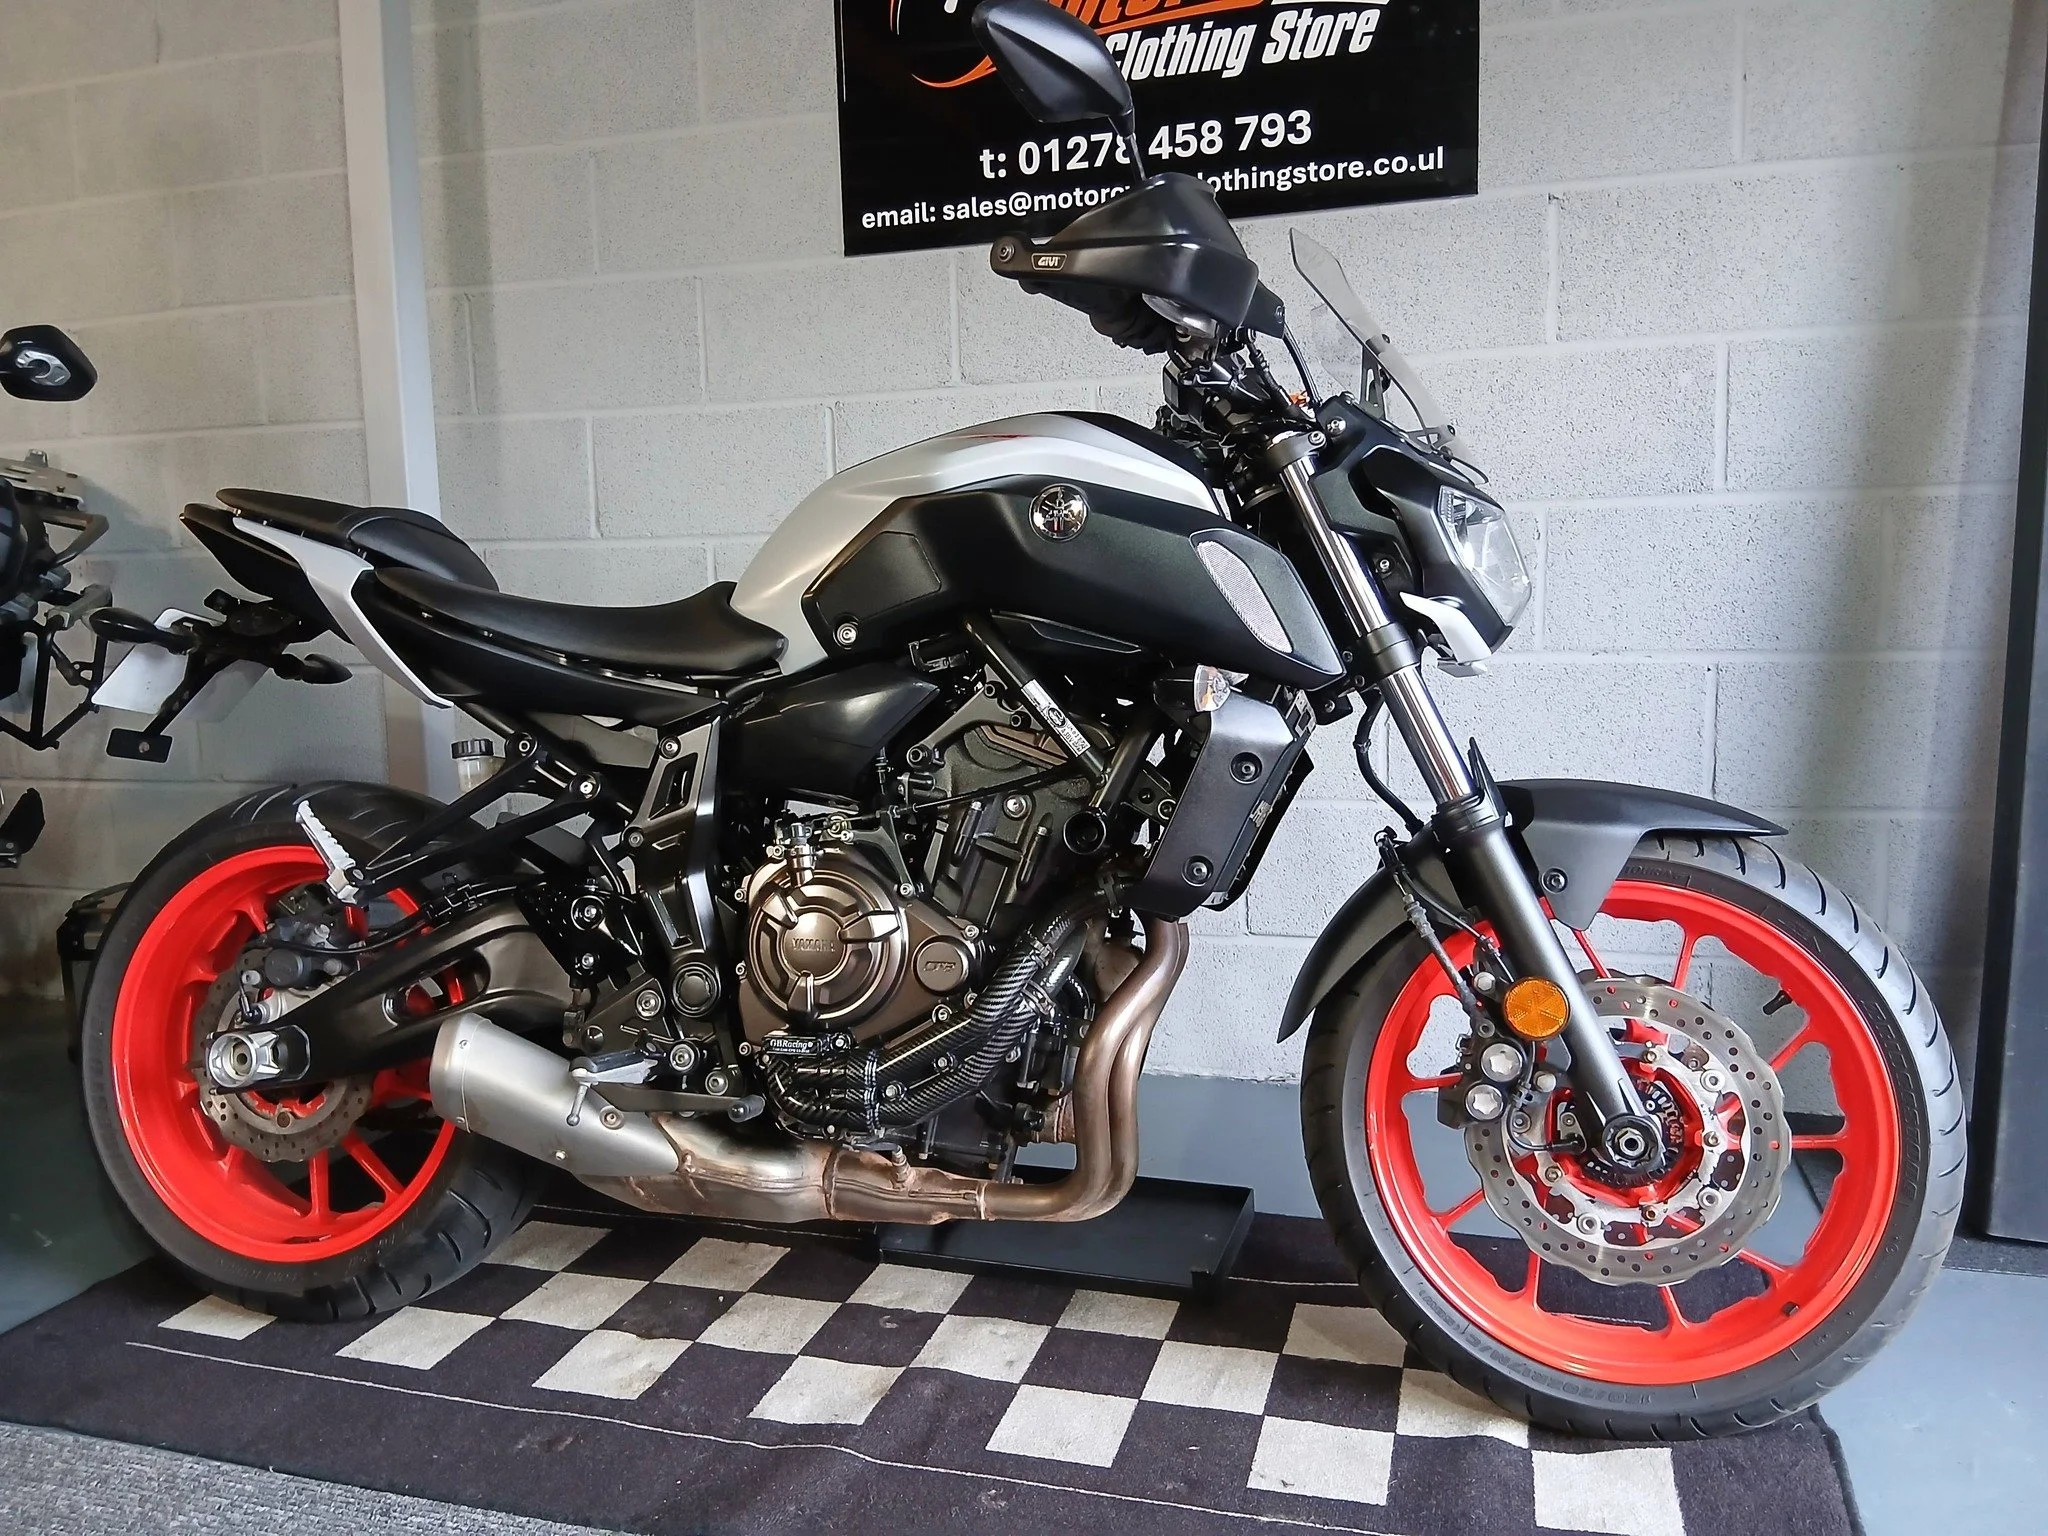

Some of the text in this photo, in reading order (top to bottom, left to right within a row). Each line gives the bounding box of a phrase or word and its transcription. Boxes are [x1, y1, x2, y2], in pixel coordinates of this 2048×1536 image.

[1105, 21, 1257, 79] Clothing
[1262, 8, 1381, 64] Store
[979, 149, 1007, 179] t:
[1148, 120, 1224, 160] 458
[1234, 110, 1312, 152] 793
[861, 202, 936, 229] email:
[1037, 256, 1060, 267] GIVI
